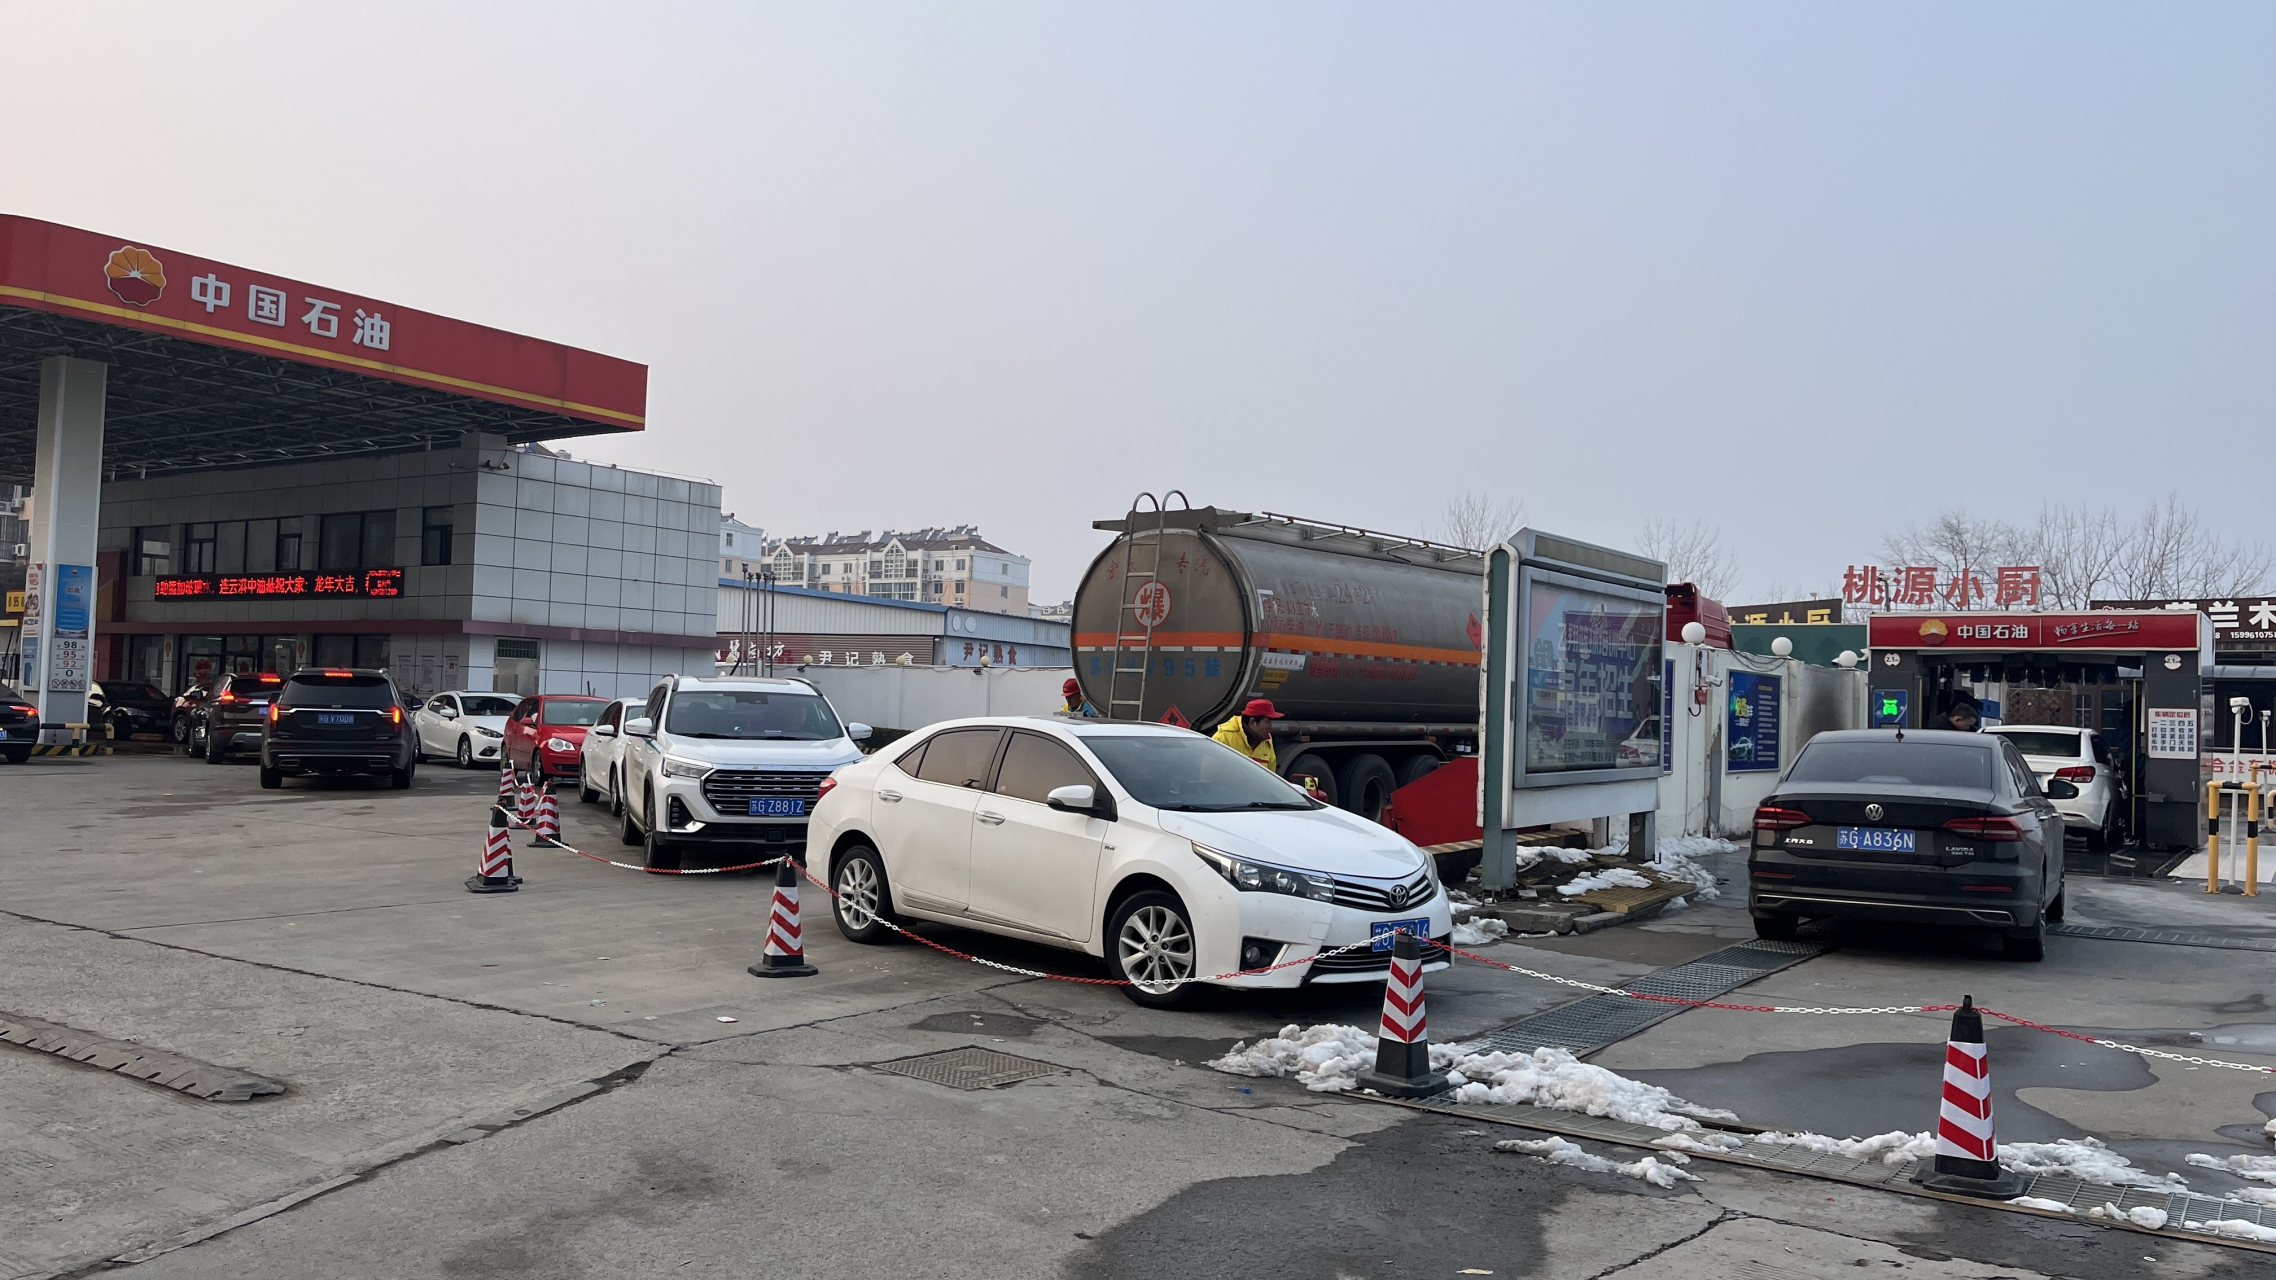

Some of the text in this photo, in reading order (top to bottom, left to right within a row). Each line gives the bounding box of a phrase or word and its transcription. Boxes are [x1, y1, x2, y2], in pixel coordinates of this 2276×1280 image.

[191, 273, 390, 351] 中国石油
[1843, 565, 2041, 607] 桃源小厨
[1139, 587, 1165, 621] 爆
[1957, 624, 2029, 639] 中国石油
[63, 640, 77, 649] 98
[63, 650, 77, 659] 95
[963, 641, 1017, 666] 尹记熟食
[62, 660, 76, 668] 92
[65, 669, 73, 677] 0
